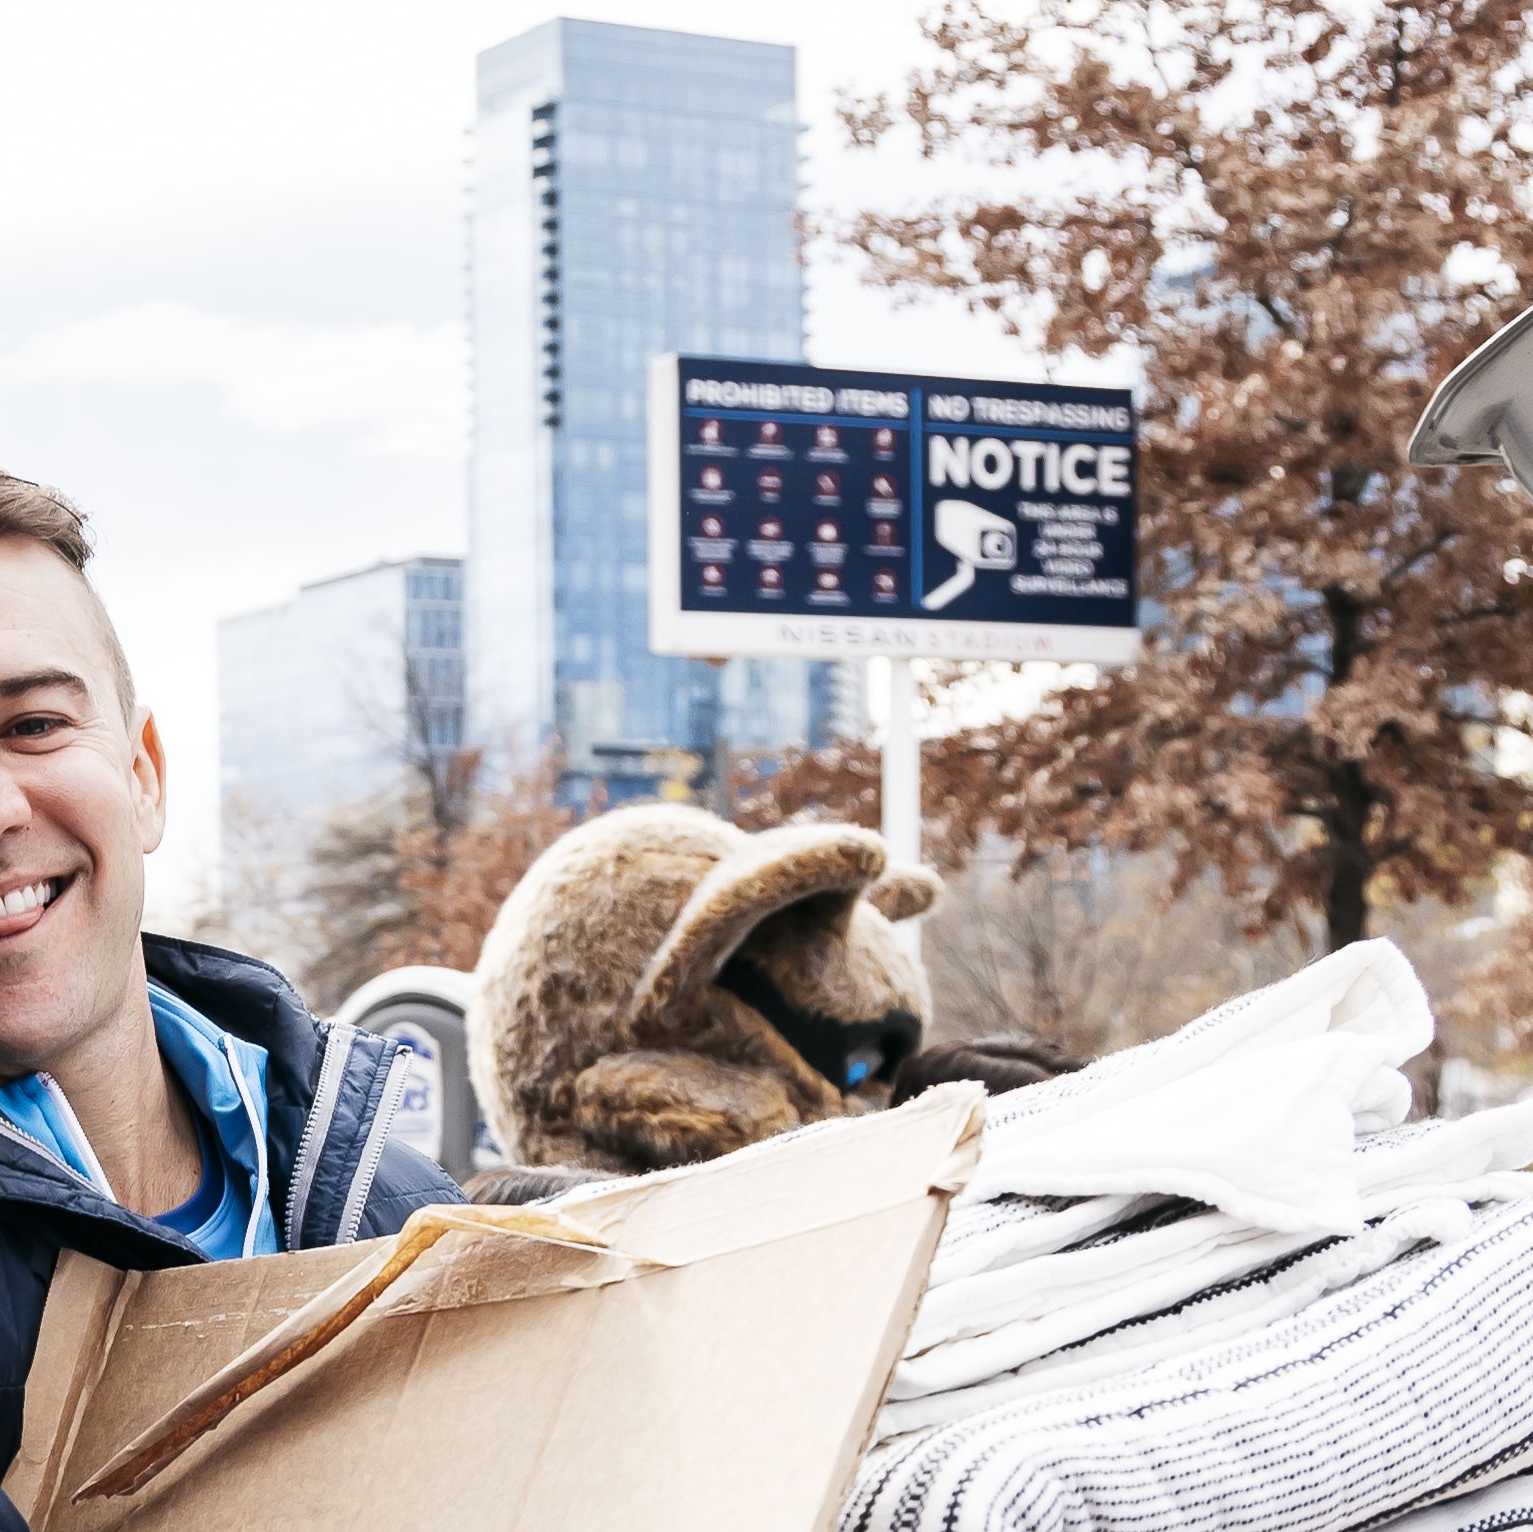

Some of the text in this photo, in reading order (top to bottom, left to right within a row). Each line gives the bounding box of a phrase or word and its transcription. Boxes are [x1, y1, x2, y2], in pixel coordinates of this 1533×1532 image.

[686, 379, 909, 418] PROHIBITED ITEMS
[928, 395, 1130, 431] NO TRESPASSING
[928, 435, 1131, 497] NOTICE
[781, 624, 916, 646] NISSAN
